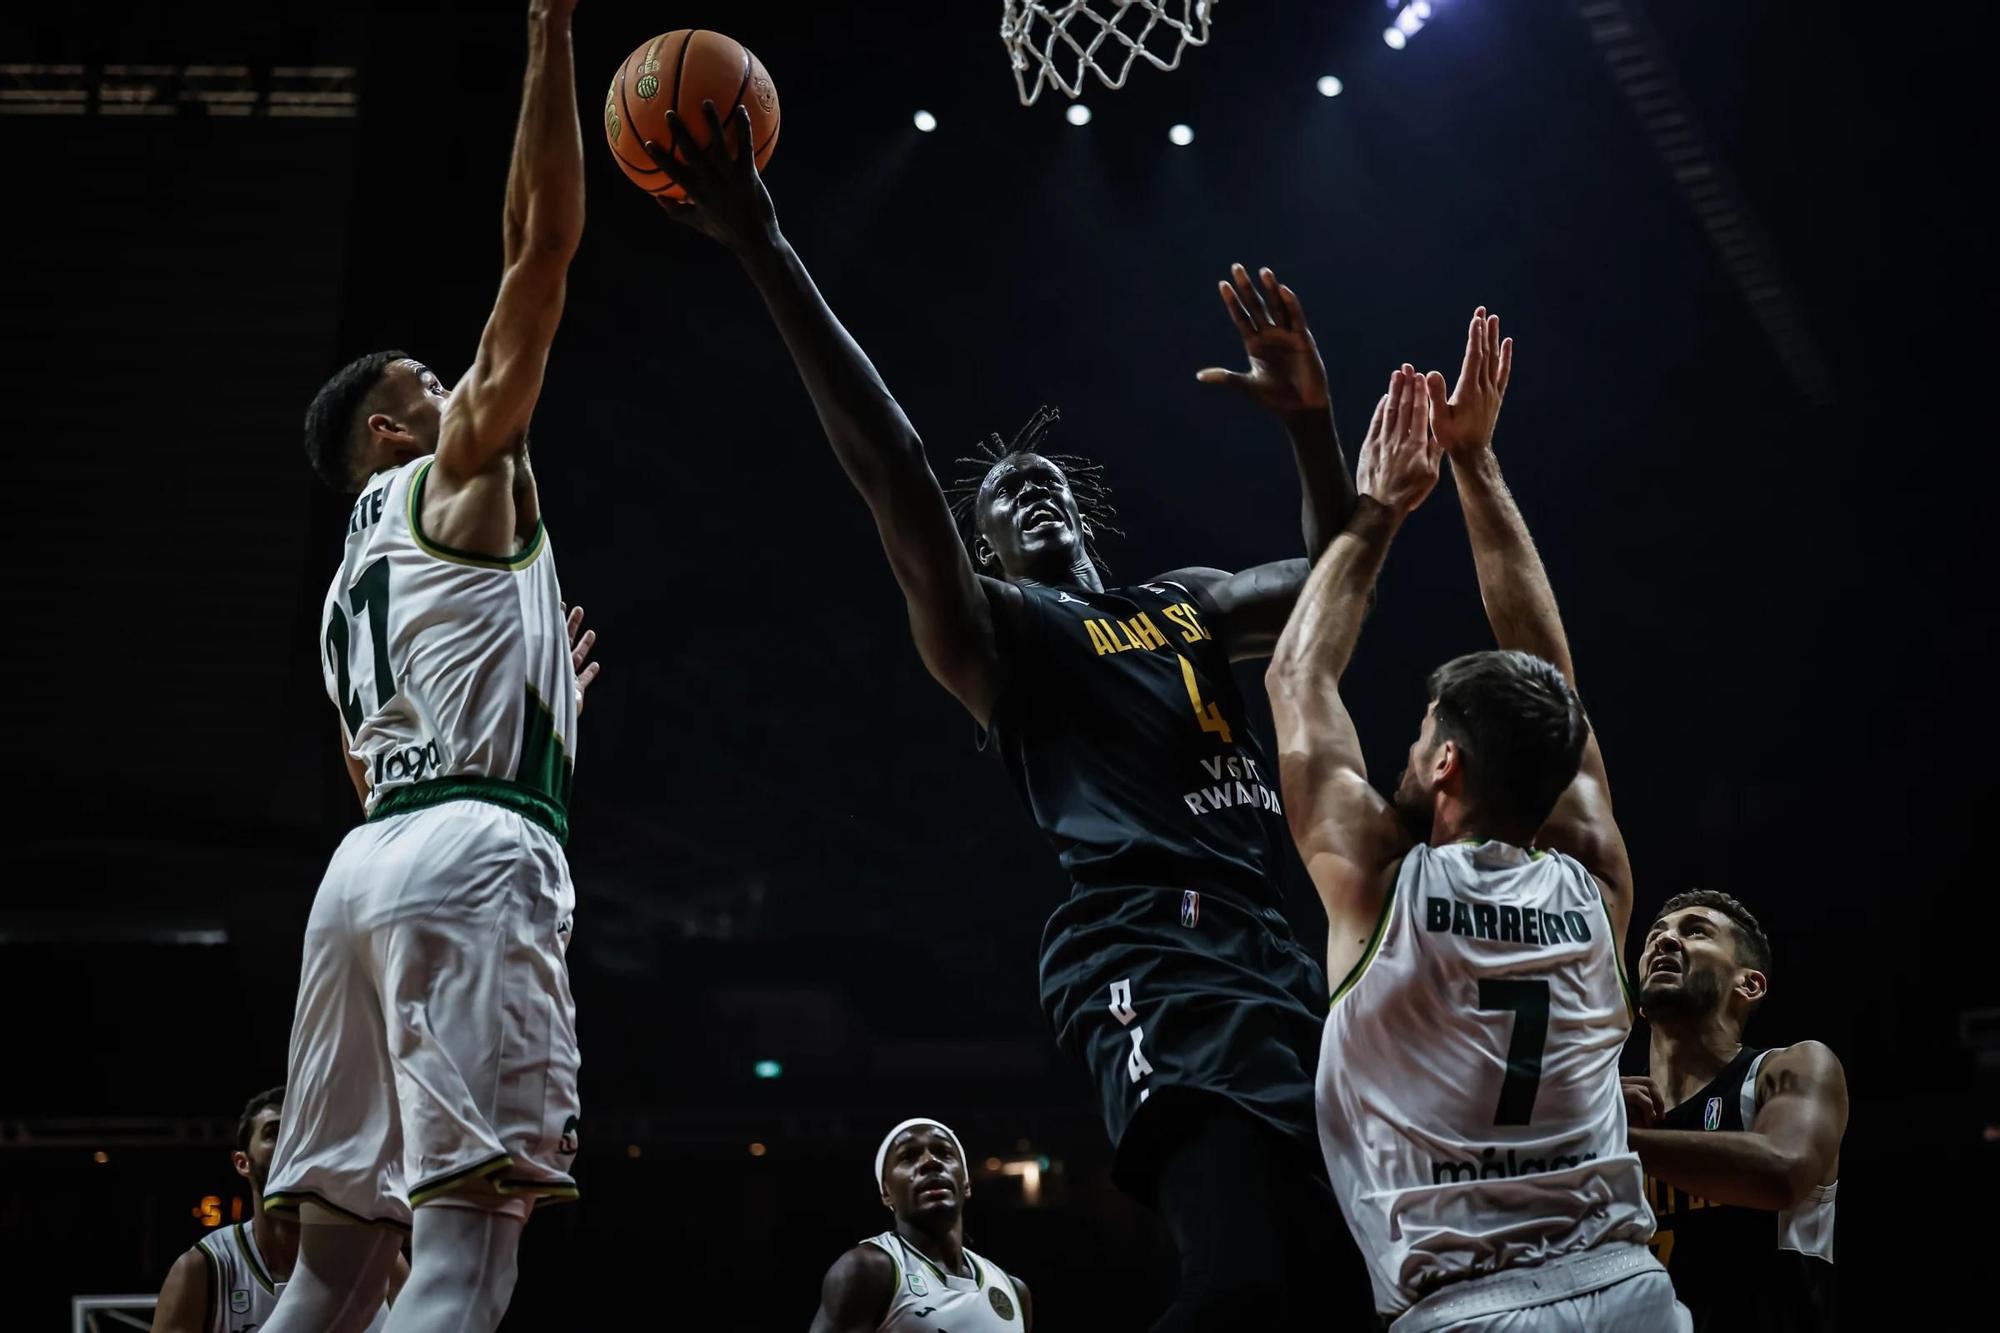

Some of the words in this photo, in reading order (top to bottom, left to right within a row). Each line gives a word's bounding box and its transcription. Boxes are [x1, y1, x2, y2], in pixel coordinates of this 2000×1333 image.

[326, 555, 397, 741] 21
[1161, 603, 1212, 644] SC
[1176, 652, 1233, 743] 4
[1183, 781, 1282, 816] RWANDA
[1427, 897, 1592, 945] BARREIRO
[1478, 980, 1549, 1125] 7
